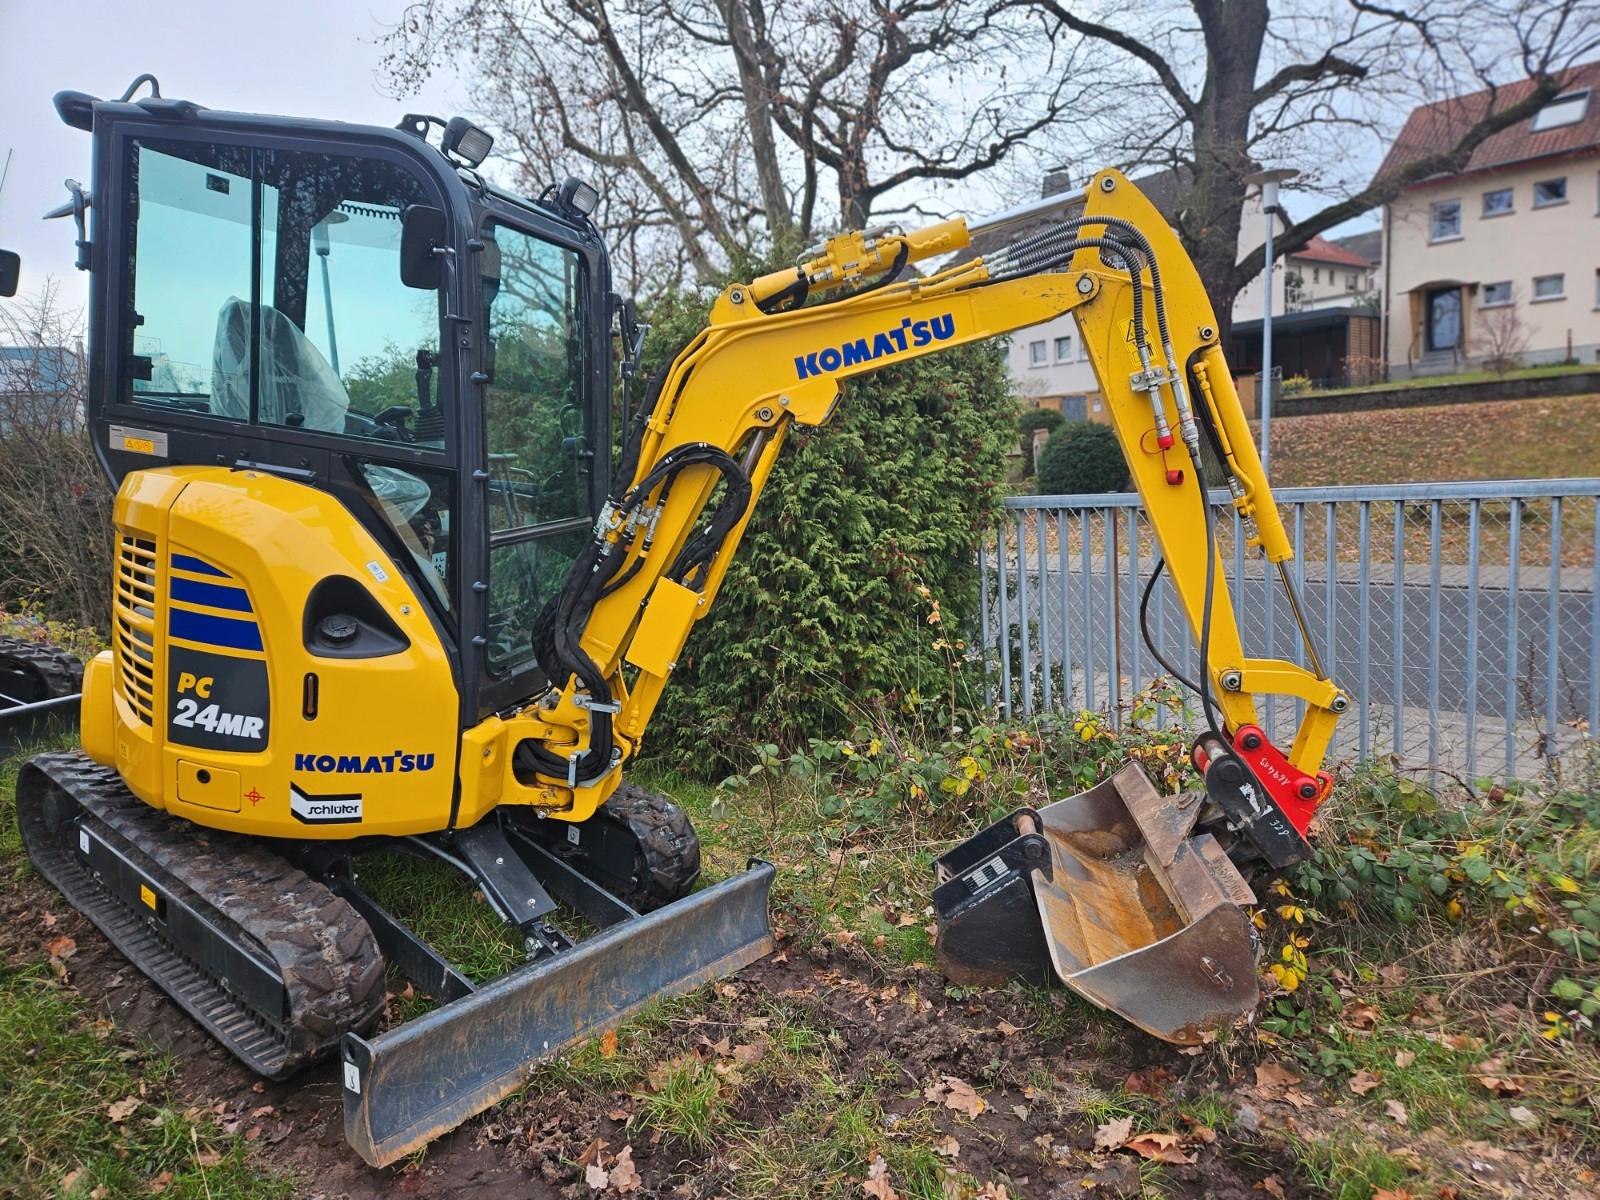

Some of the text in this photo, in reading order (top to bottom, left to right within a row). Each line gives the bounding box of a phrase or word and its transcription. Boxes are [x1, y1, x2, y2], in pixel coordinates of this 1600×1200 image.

[794, 313, 955, 380] KOMATSU
[177, 672, 213, 699] PC
[172, 698, 263, 739] 24MR
[294, 750, 435, 773] KOMATSU
[307, 804, 360, 815] schlüter
